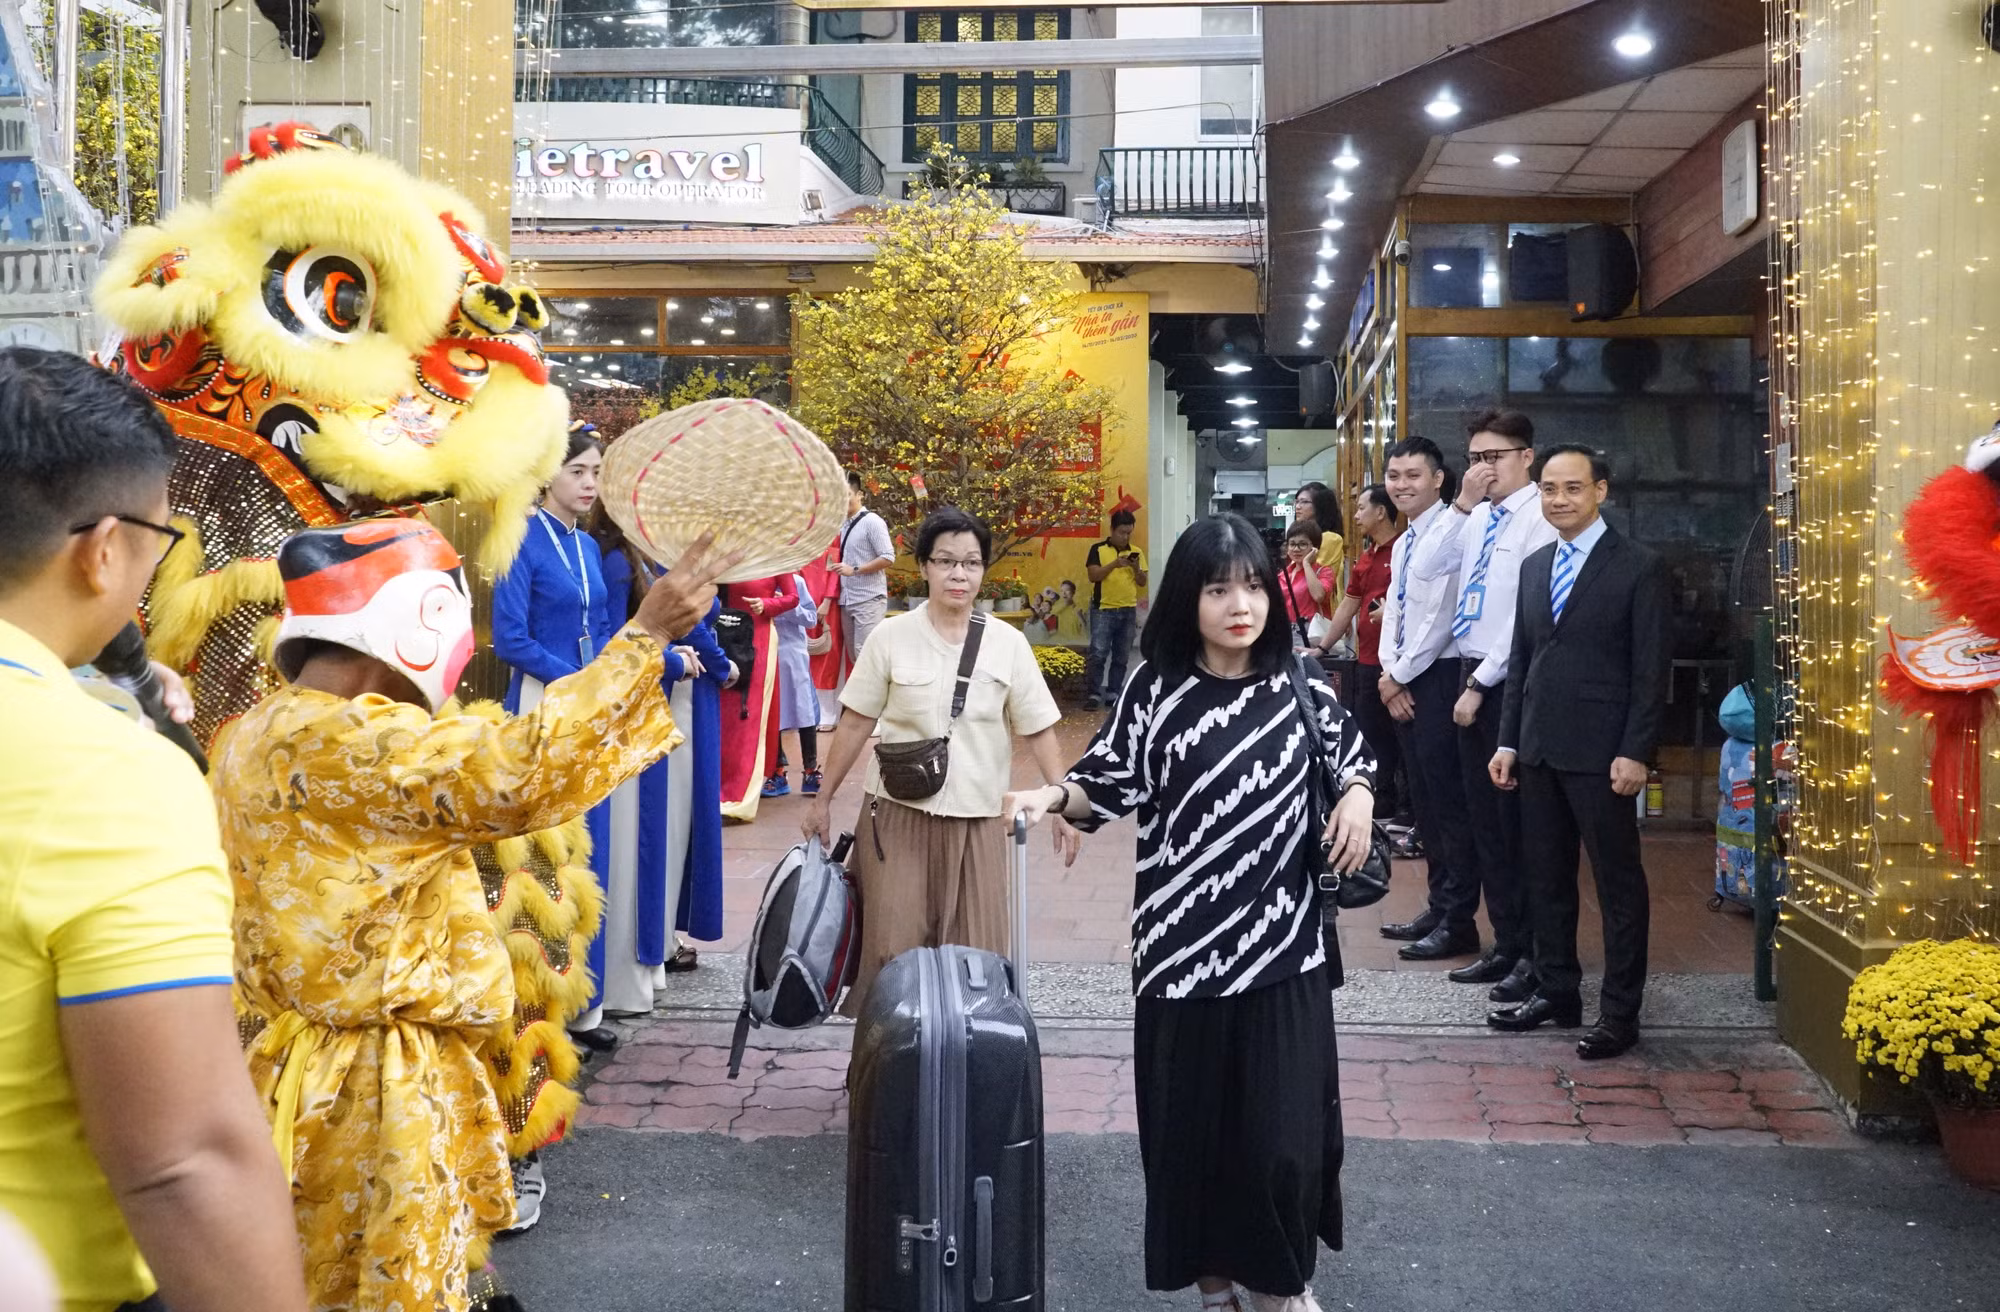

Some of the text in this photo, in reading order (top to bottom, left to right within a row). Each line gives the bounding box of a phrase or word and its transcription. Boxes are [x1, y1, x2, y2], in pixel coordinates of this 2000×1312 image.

[515, 137, 765, 184] ietravel
[515, 181, 763, 200] LEADING TOUR OPERATOR
[1082, 310, 1140, 339] thêm gần
[1101, 311, 1113, 323] ta
